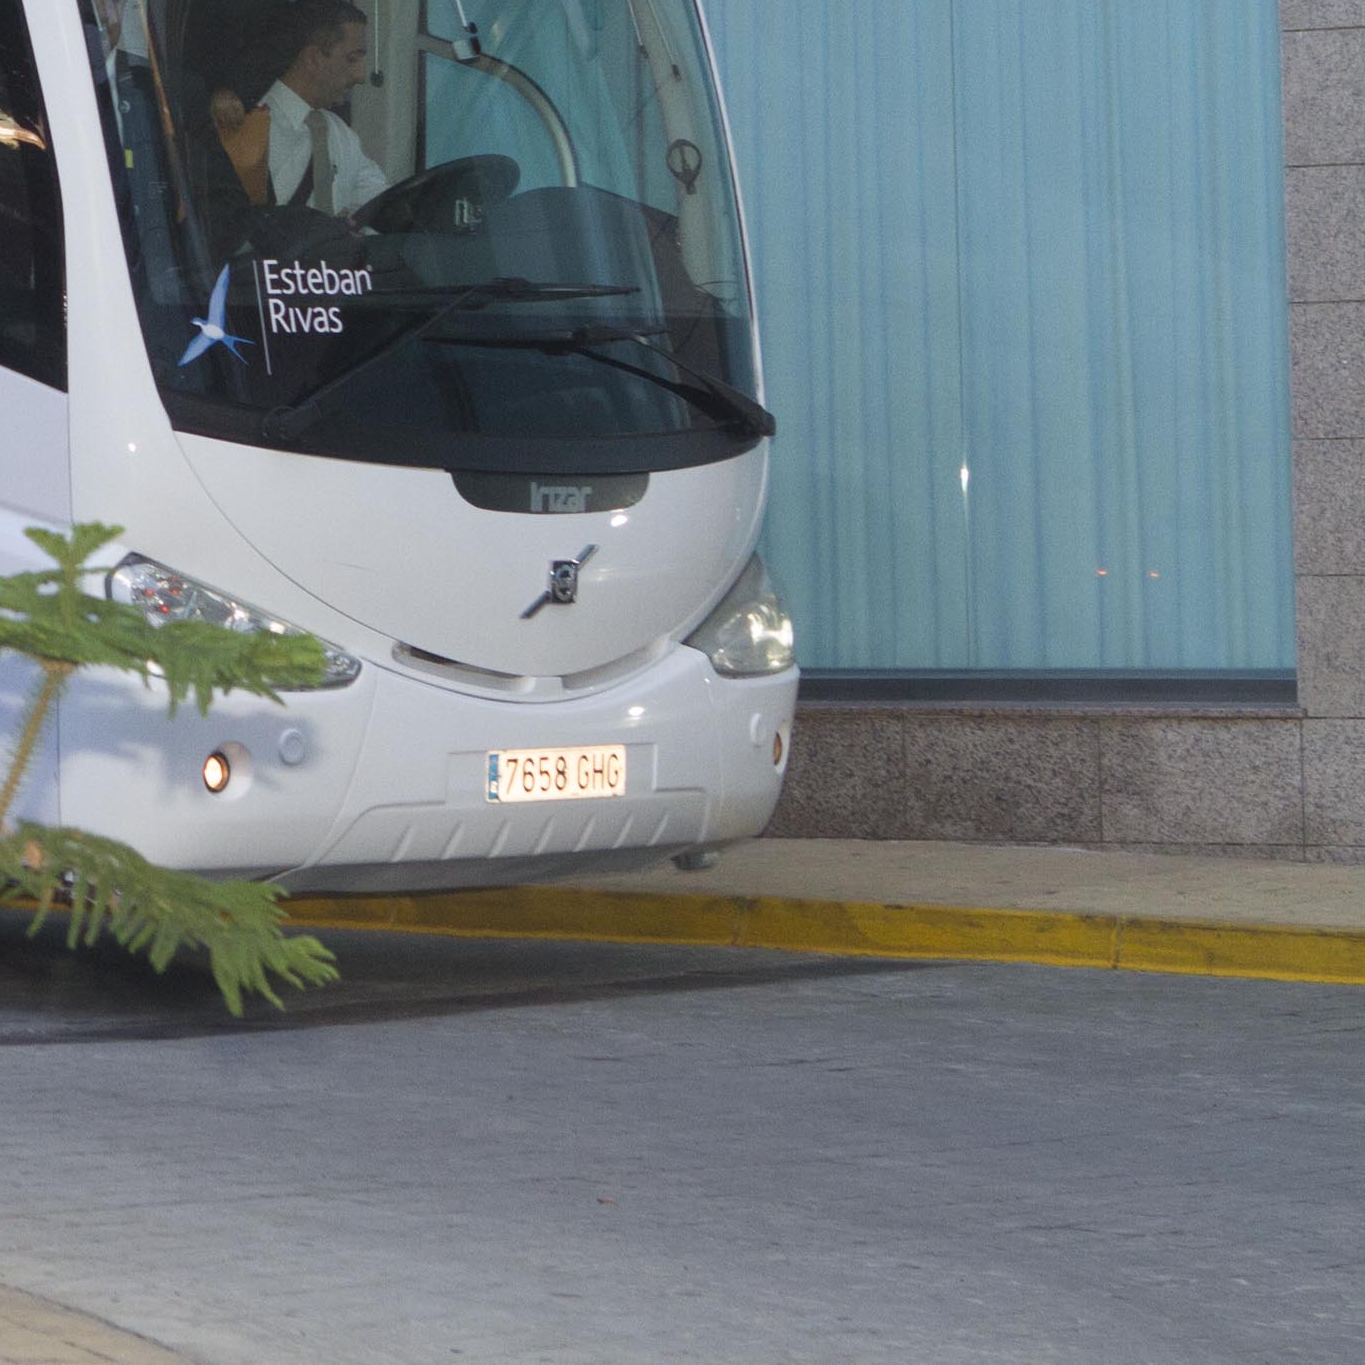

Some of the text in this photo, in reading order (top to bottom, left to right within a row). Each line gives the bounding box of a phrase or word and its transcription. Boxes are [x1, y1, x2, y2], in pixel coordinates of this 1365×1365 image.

[263, 259, 373, 295] Esteban
[268, 298, 343, 333] Rivas
[506, 753, 619, 794] 7658 GHG
